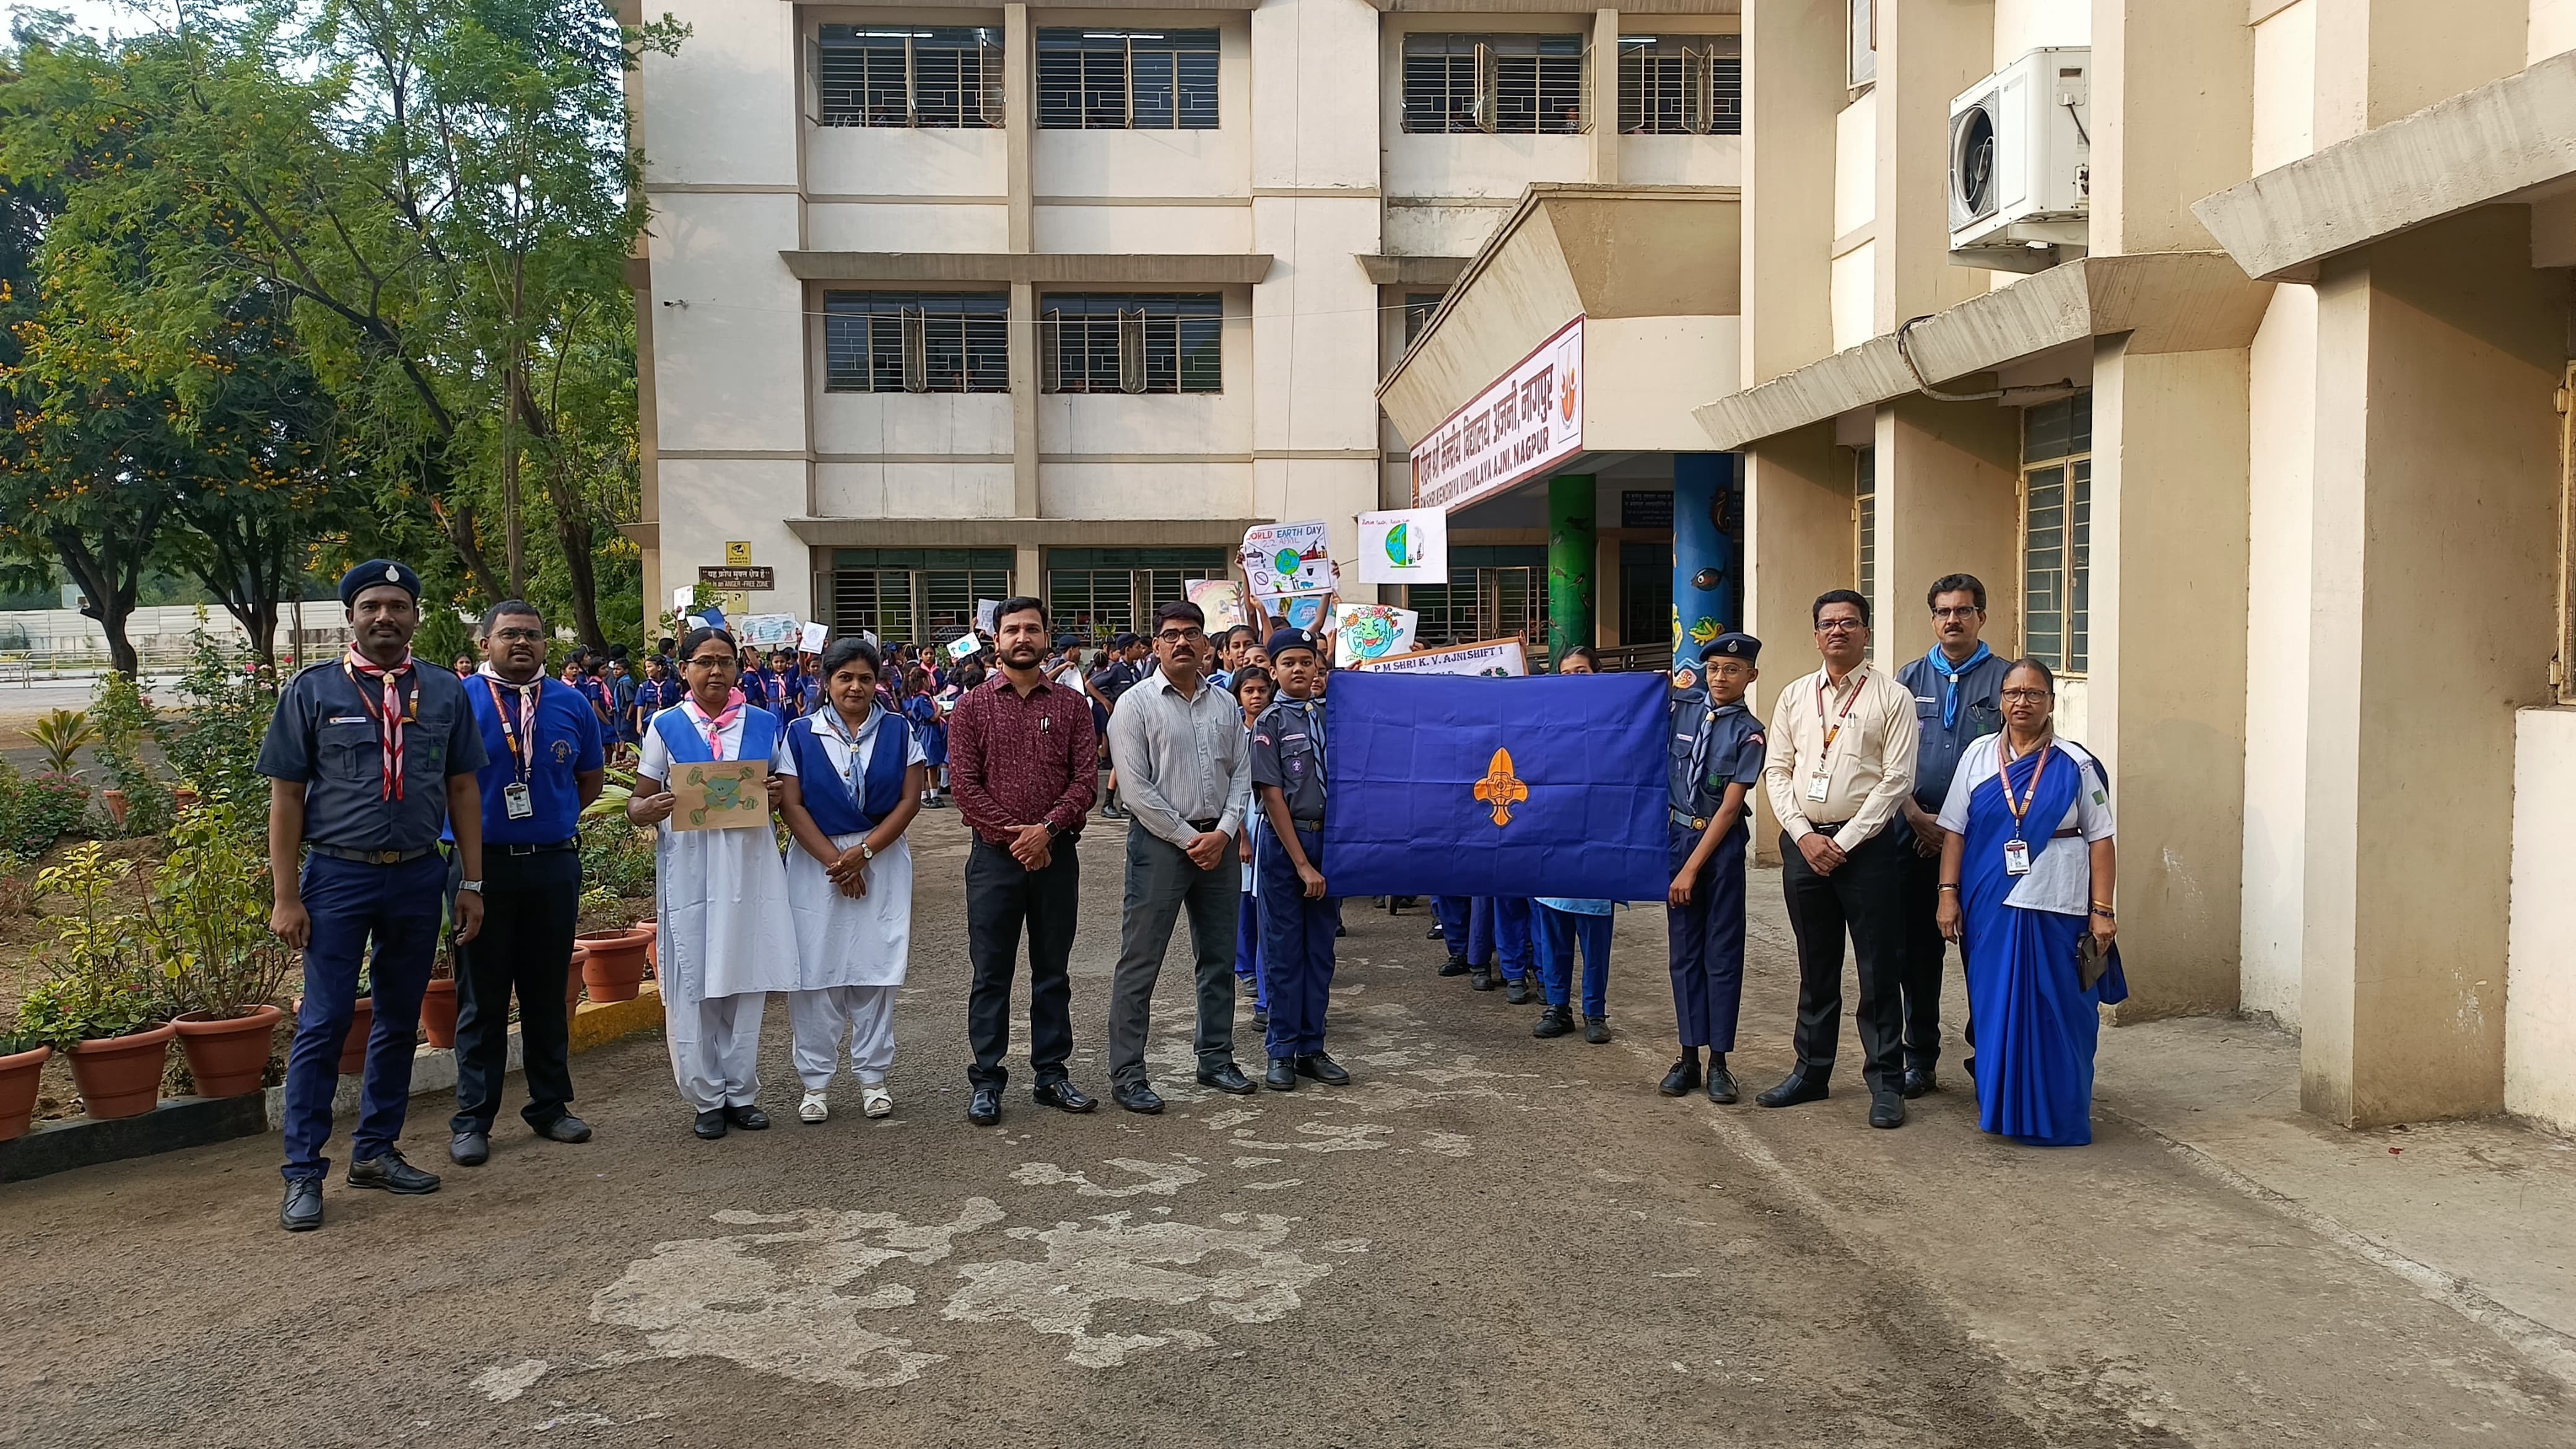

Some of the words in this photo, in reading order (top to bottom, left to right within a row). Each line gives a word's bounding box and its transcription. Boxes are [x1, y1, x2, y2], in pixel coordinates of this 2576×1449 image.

[1464, 409, 1490, 462] विद्यालय
[1521, 363, 1553, 424] नागपुर
[1437, 477, 1460, 506] KENDRIYA
[1460, 459, 1492, 494] VIDYALAYA
[1494, 448, 1512, 478] AJNI,
[1514, 426, 1549, 468] NAGPUR
[1277, 528, 1302, 538] EARTH
[1306, 526, 1322, 535] DAY
[1393, 659, 1417, 670] SHRI
[1419, 658, 1429, 667] K.
[1432, 656, 1442, 665] V.
[1443, 652, 1466, 663] AJNI
[1468, 647, 1495, 659] SHIFT
[1499, 646, 1503, 655] 1
